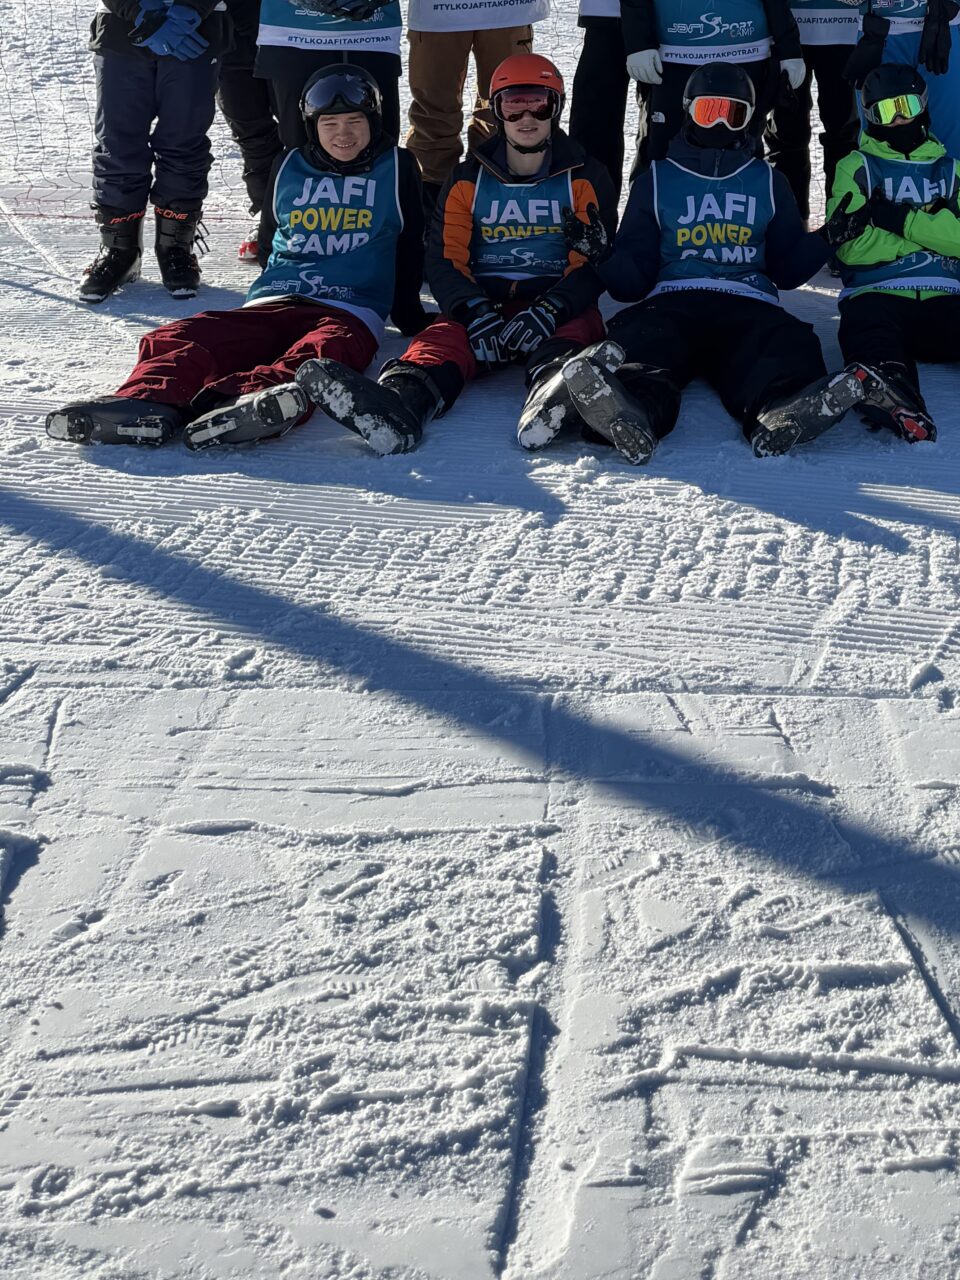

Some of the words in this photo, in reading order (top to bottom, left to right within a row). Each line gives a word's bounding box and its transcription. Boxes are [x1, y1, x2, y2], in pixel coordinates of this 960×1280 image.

[664, 47, 759, 60] #TYLKOJAFITAKPOTRAFI
[292, 176, 376, 207] JAFI
[290, 207, 373, 231] POWER
[481, 199, 562, 224] JAFI
[677, 192, 757, 225] JAFI
[287, 232, 370, 256] CAMP
[676, 222, 753, 247] POWER
